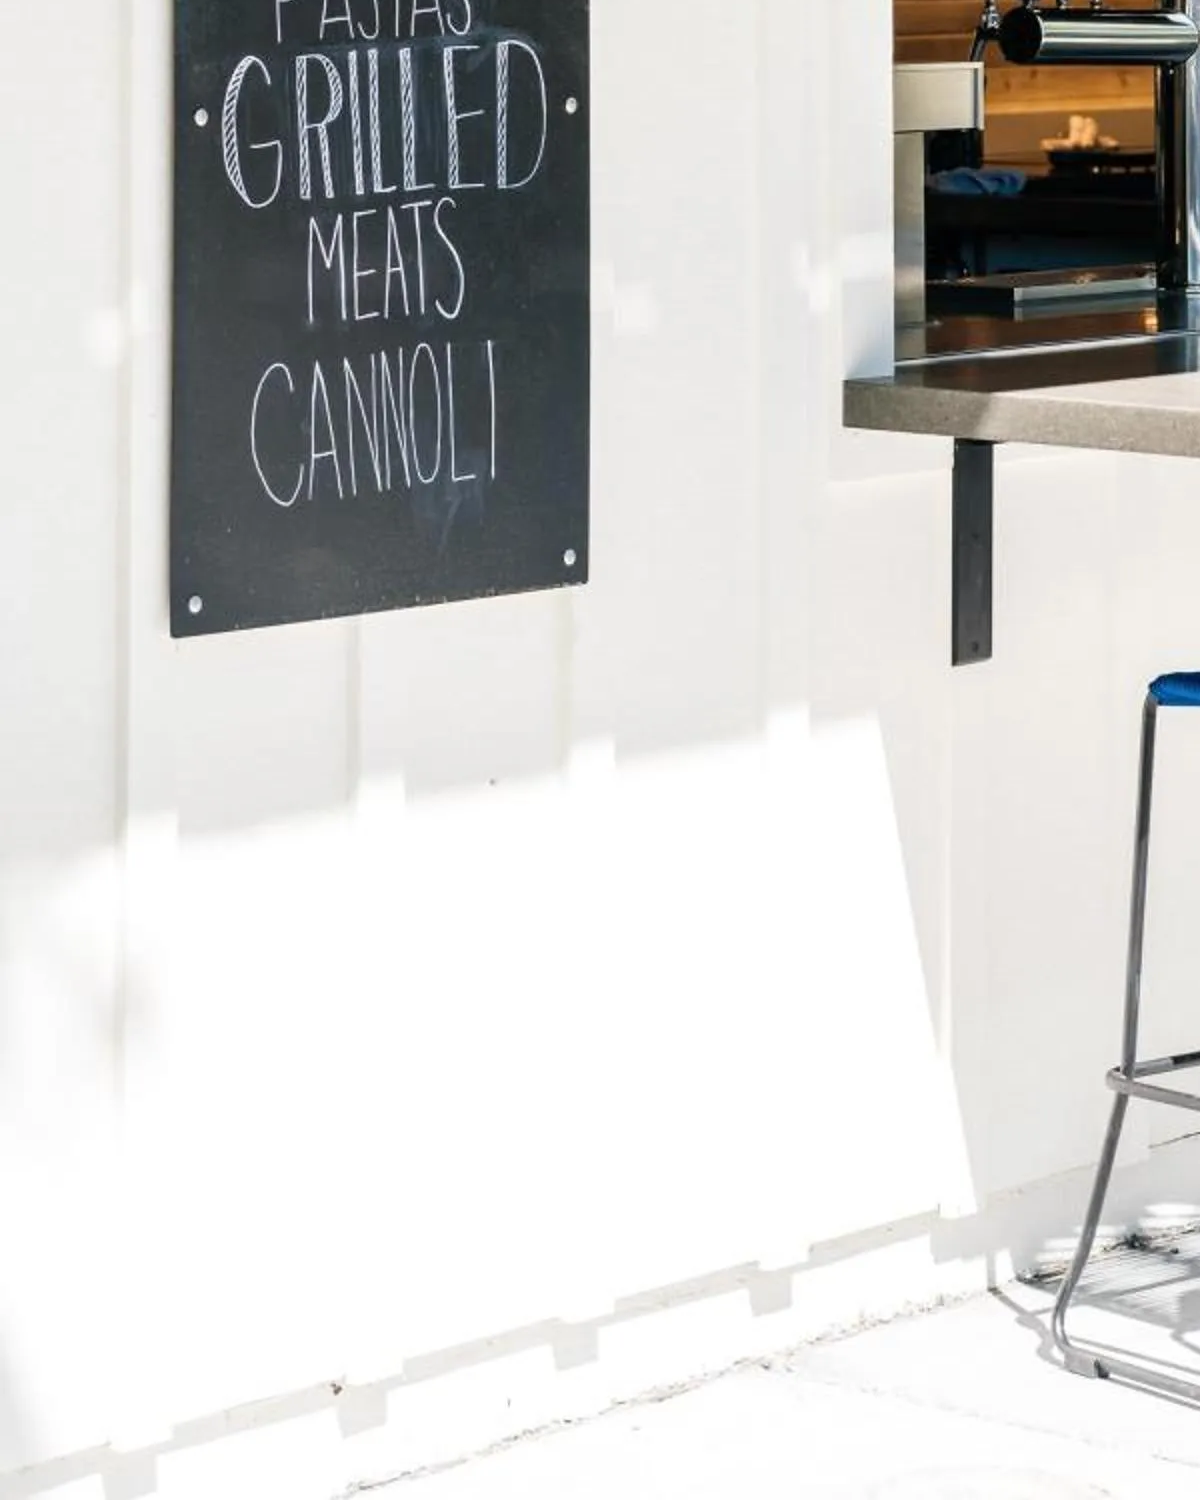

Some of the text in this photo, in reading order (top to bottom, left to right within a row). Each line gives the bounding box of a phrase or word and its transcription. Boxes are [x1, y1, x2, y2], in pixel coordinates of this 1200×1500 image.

[221, 38, 547, 209] GRILLED
[306, 197, 465, 325] MEATS
[250, 339, 496, 507] CANNOLI
